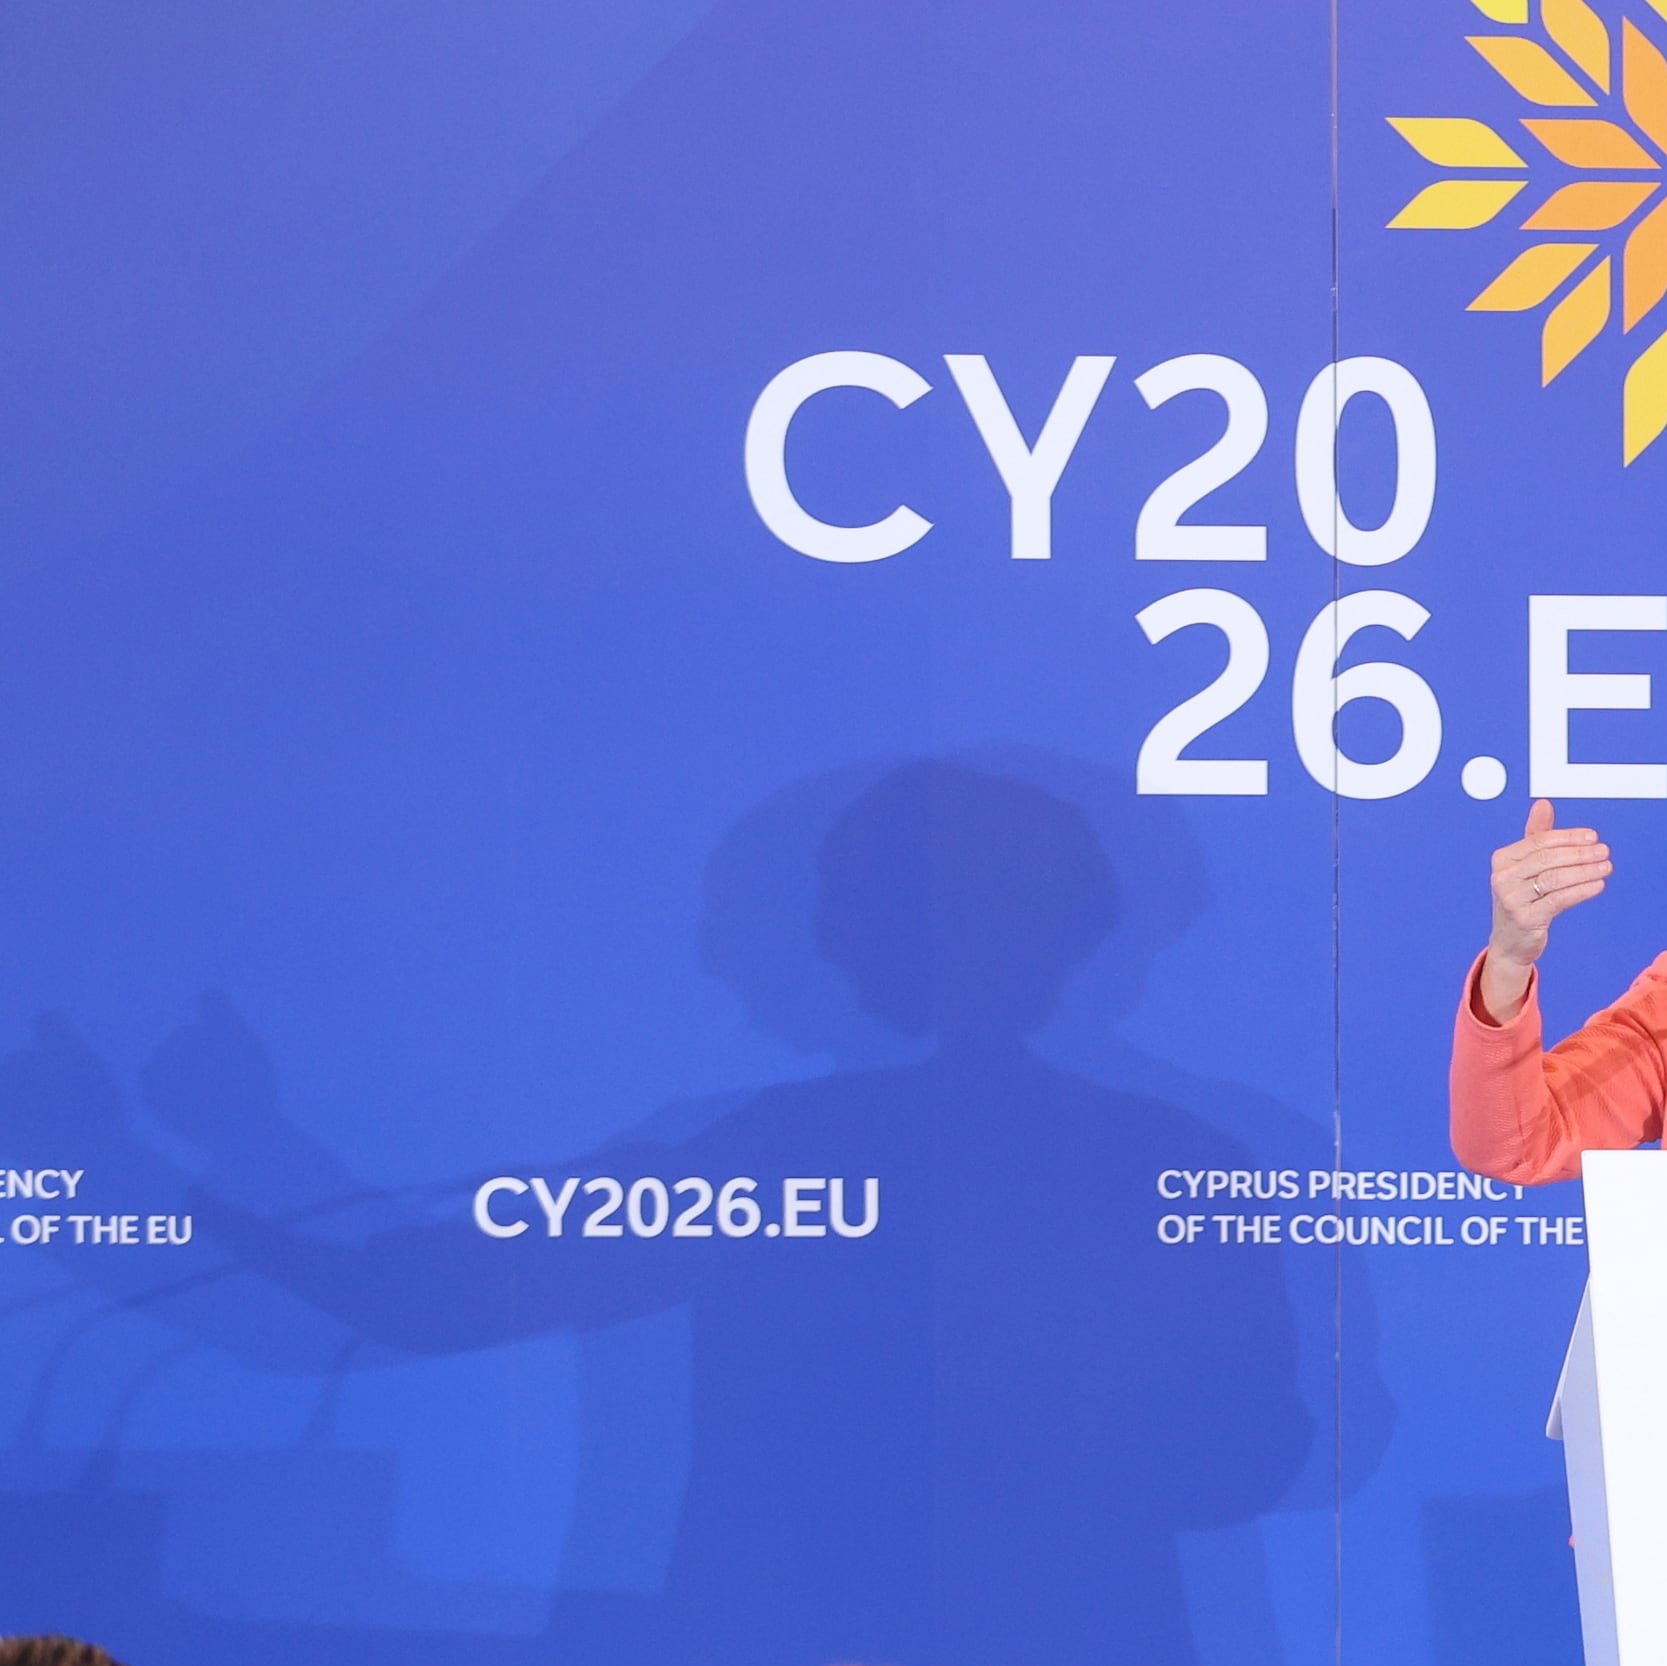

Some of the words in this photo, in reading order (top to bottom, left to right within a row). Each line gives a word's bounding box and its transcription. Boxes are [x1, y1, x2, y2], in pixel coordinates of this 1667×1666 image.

[744, 350, 1438, 566] CY20
[1156, 1169, 1301, 1200] CYPRUS
[473, 1176, 880, 1239] CY2026.EU
[10, 1214, 62, 1245] OF
[66, 1214, 140, 1245] THE
[146, 1214, 193, 1246] EU
[1156, 1214, 1206, 1245] OF
[1212, 1214, 1283, 1245] THE
[1288, 1214, 1455, 1246] COUNCIL
[1459, 1215, 1510, 1246] OF
[1514, 1216, 1584, 1246] THE
